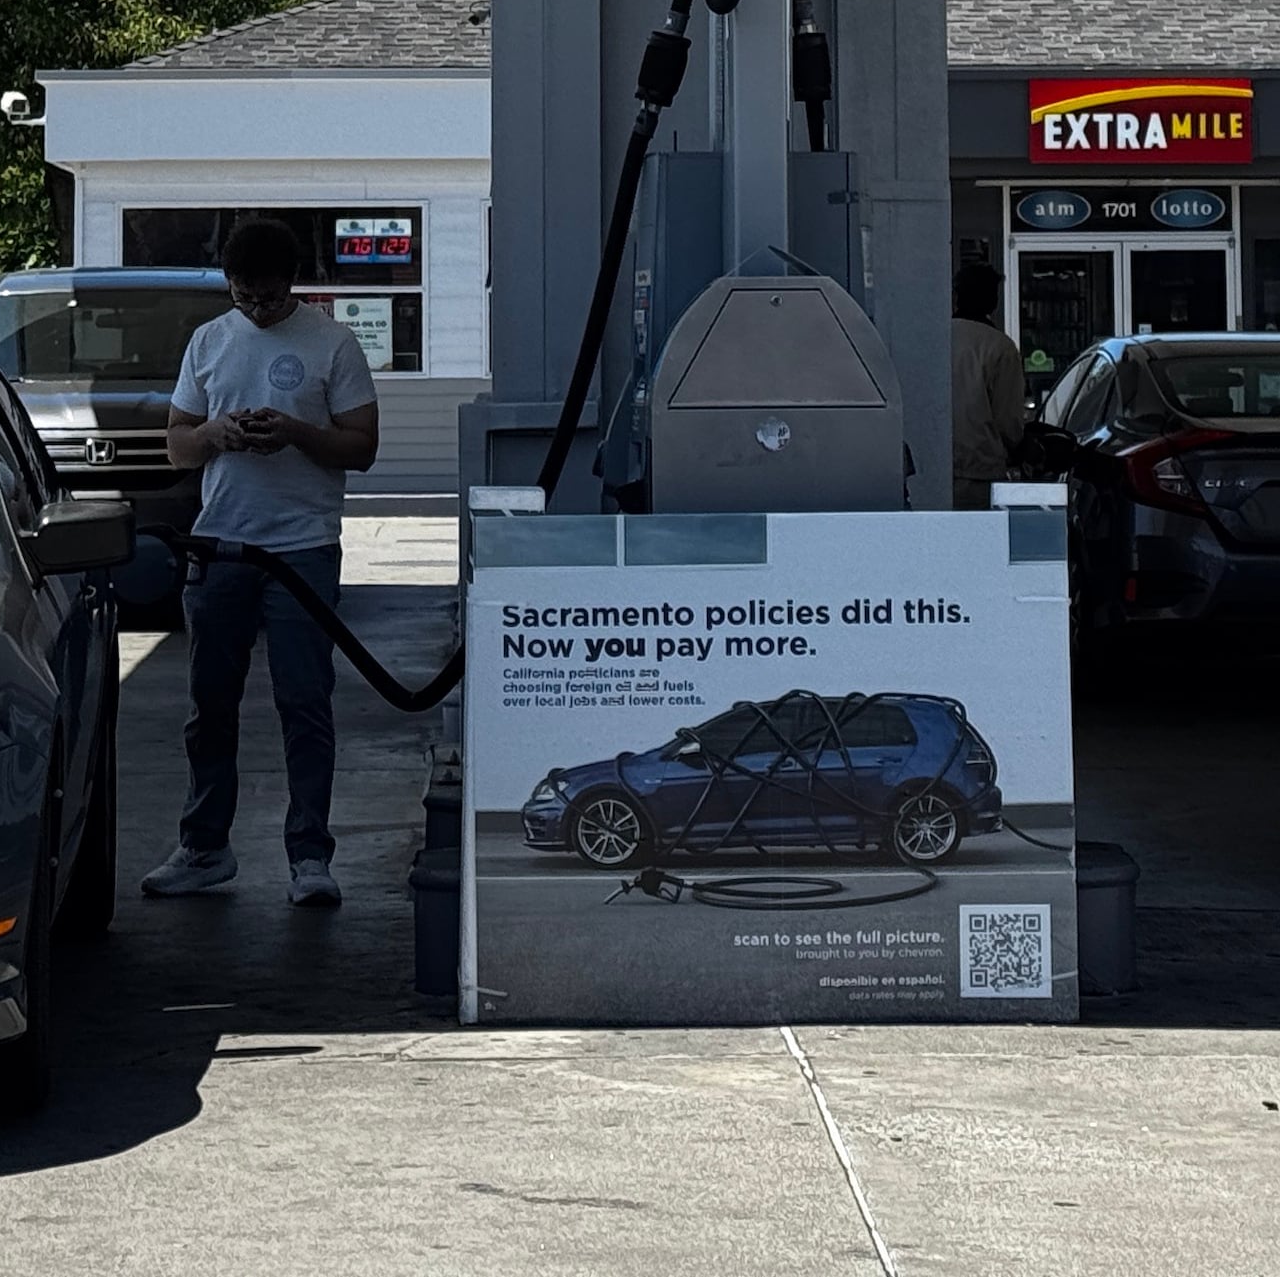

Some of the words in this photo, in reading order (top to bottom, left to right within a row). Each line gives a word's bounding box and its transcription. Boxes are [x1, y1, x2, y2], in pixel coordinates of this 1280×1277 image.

[1035, 201, 1075, 216] atm
[1102, 202, 1136, 218] 1701
[1162, 199, 1212, 216] lotto
[502, 602, 695, 628] Sacramento
[705, 599, 831, 630] policies
[841, 599, 892, 624] did
[903, 598, 971, 624] this.
[503, 634, 574, 658] Now
[584, 637, 645, 662] you
[656, 637, 714, 662] pay
[725, 636, 817, 657] more.
[503, 668, 566, 679] California
[503, 682, 561, 695] choosing
[566, 681, 612, 694] foreign
[663, 680, 695, 692] fuels
[503, 698, 531, 707] over
[535, 695, 566, 707] local
[629, 694, 665, 706] lower
[668, 694, 706, 706] costs.
[734, 934, 770, 946] scan
[774, 933, 791, 946] to
[795, 934, 822, 945] see
[826, 931, 852, 945] the
[856, 930, 882, 944] full
[886, 930, 945, 946] picture.
[796, 949, 840, 960] brought
[844, 949, 856, 959] to
[858, 950, 879, 960] you
[882, 948, 896, 959] by
[819, 976, 878, 988] disponible
[882, 978, 896, 986] en
